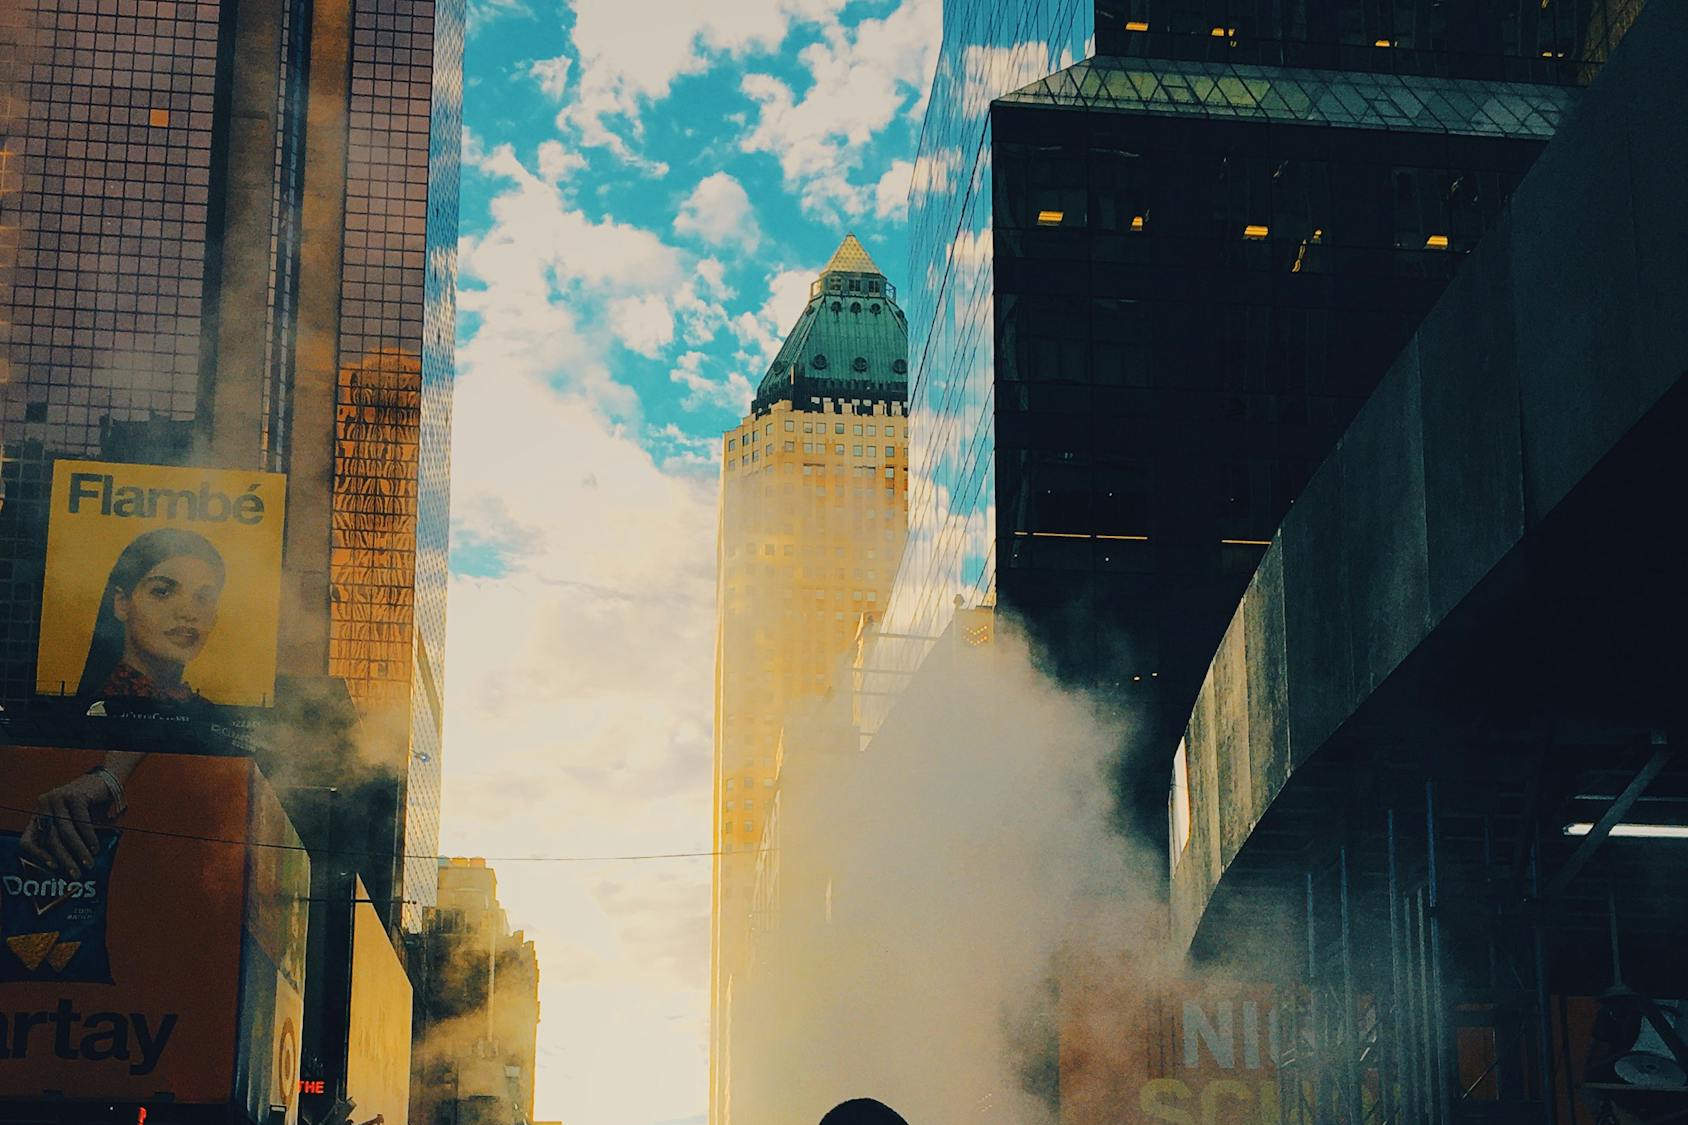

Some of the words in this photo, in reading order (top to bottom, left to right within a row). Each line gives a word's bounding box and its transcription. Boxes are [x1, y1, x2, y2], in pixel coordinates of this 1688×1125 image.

[68, 472, 265, 525] Flambé
[2, 876, 97, 898] Doritos
[0, 999, 178, 1076] rtay
